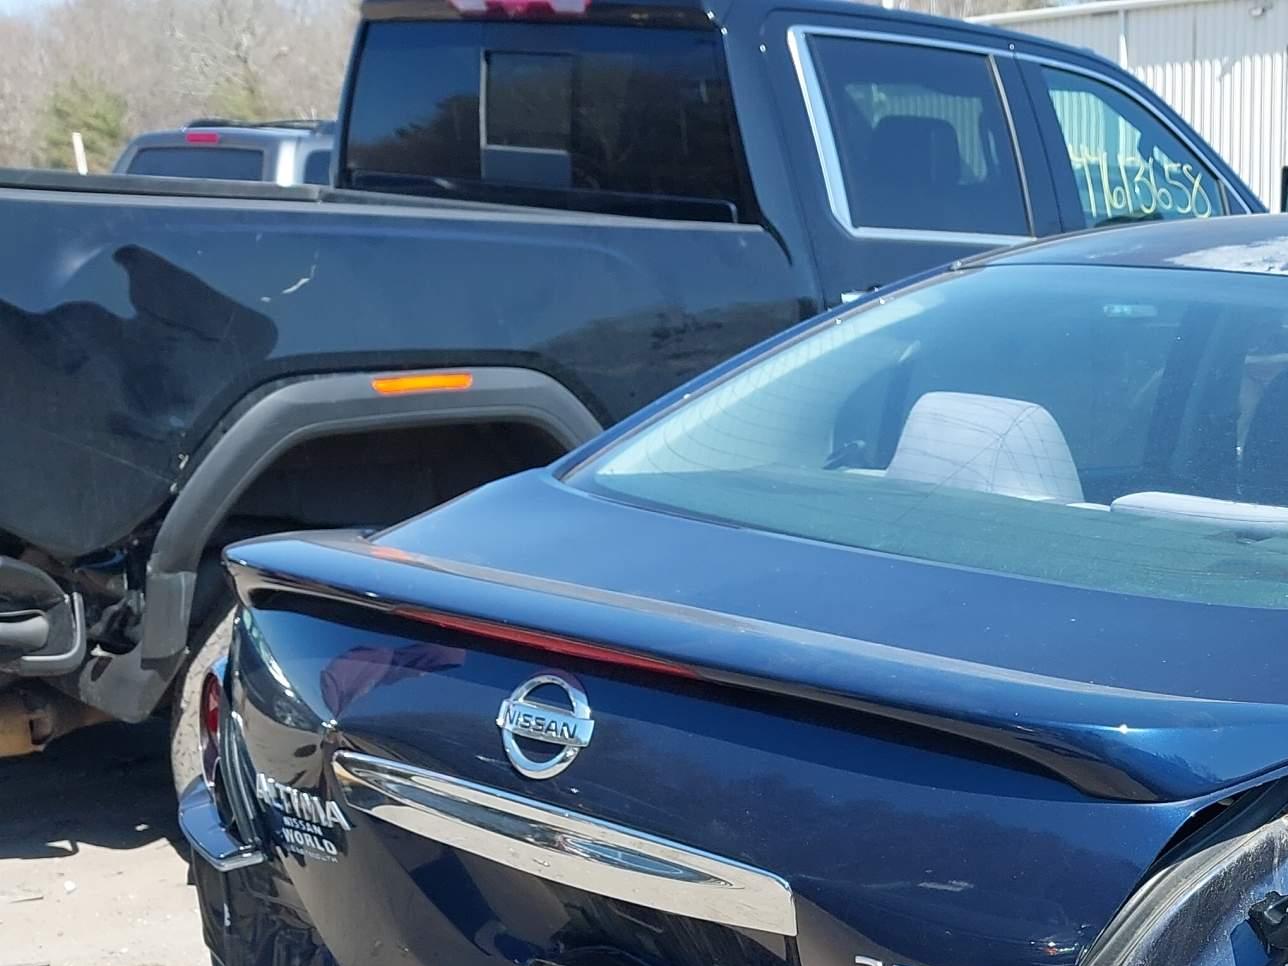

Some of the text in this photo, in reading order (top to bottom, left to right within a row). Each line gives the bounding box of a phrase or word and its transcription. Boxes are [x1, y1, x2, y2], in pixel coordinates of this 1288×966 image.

[504, 707, 578, 740] NISSAN
[282, 816, 323, 836] NISSAN
[281, 827, 338, 856] WORLD
